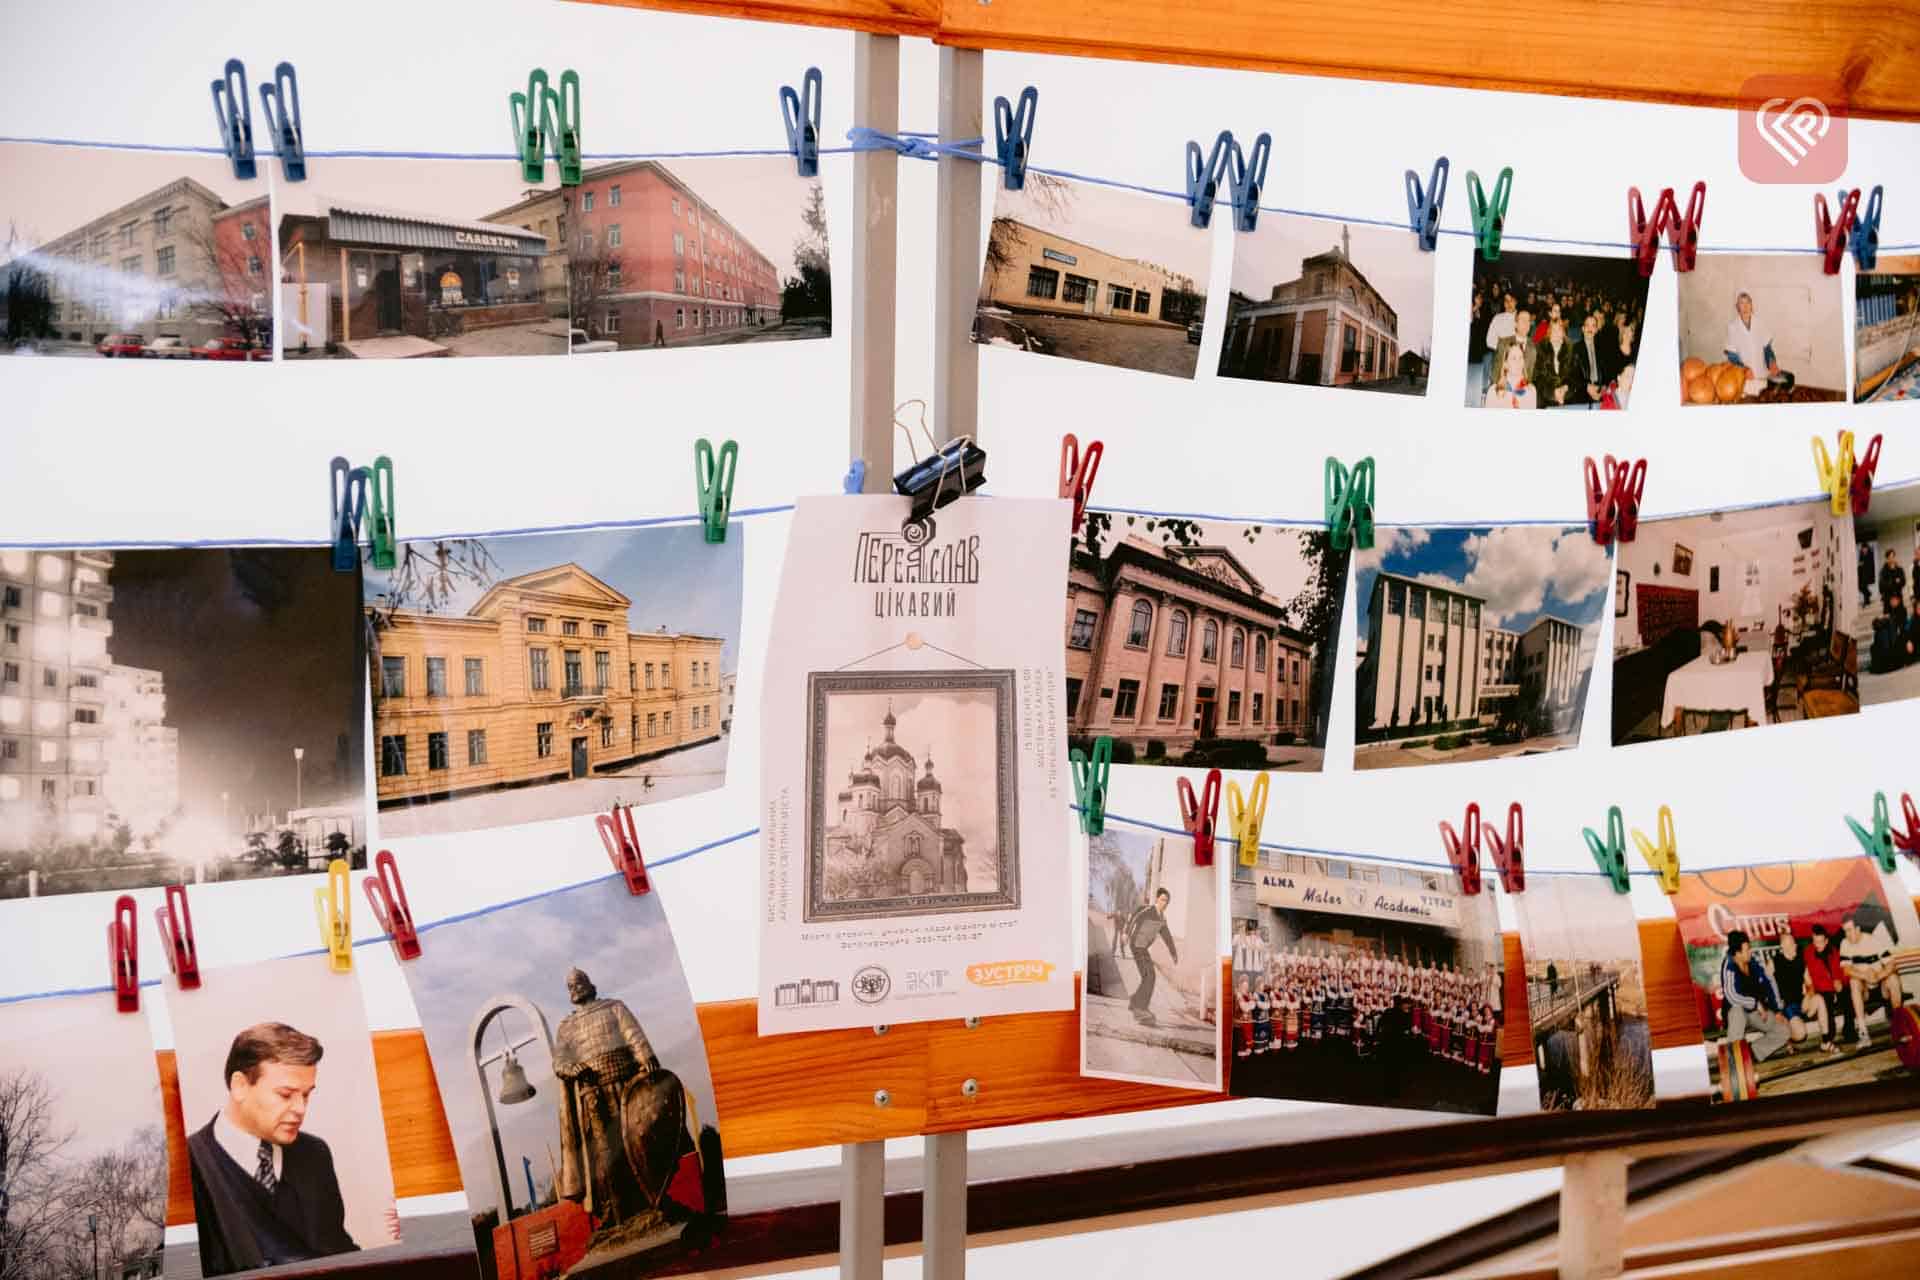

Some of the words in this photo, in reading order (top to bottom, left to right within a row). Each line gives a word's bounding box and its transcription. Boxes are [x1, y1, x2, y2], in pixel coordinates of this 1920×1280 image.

[875, 587, 956, 619] ЦІКАВИЙ
[1263, 876, 1295, 889] ALMA
[974, 963, 1045, 982] ЗУСТРІЧ
